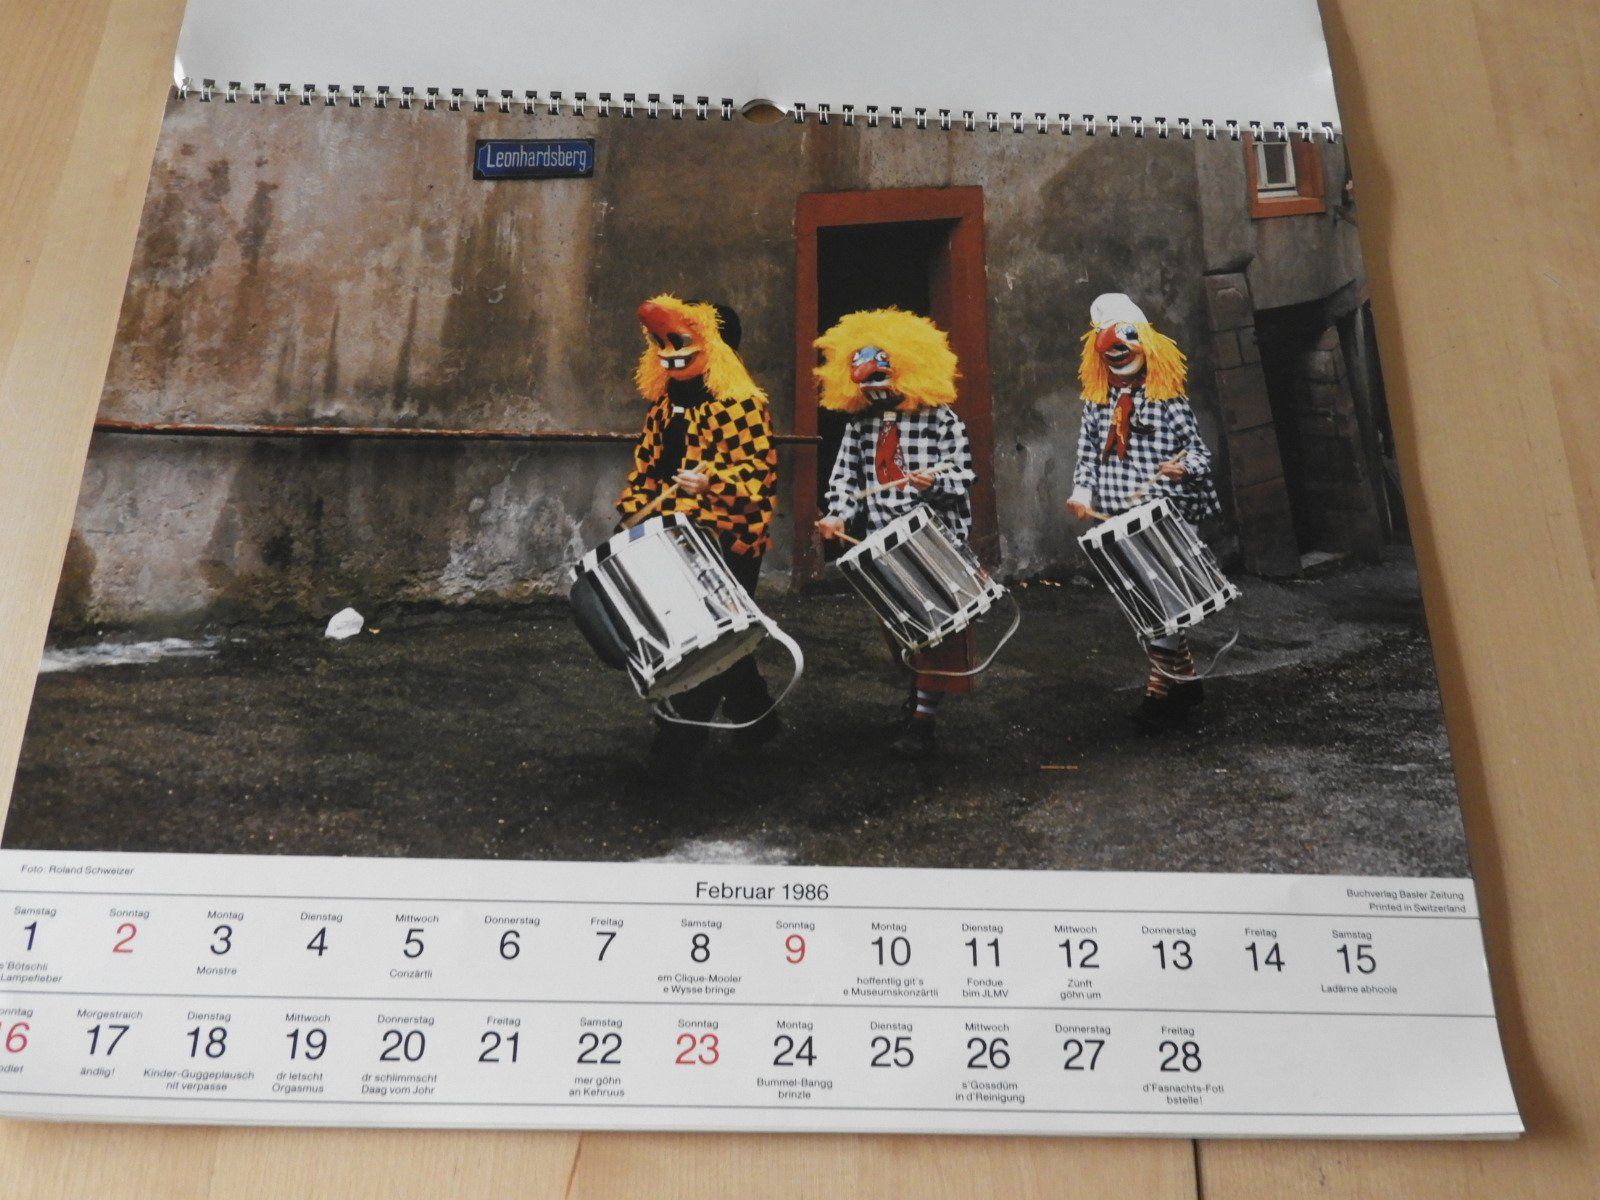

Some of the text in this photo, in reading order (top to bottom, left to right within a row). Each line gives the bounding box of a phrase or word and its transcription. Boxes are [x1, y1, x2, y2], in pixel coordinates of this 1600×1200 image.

[486, 145, 587, 172] Leonhardsberg
[48, 864, 84, 875] Roland
[84, 865, 135, 876] Schweizer
[695, 881, 829, 902] Februar 1986
[1346, 888, 1464, 901] Buchverlag Basler Zeitung
[13, 905, 57, 918] Samstag
[109, 907, 150, 920] Sonntag
[1368, 902, 1467, 914] Printed in Switzerland
[207, 909, 245, 922] Montag
[299, 911, 344, 924] Dienstag
[395, 913, 440, 924] Mittwoch
[484, 915, 541, 928] Donnerstag
[590, 916, 624, 929] Freitag
[680, 918, 723, 931] Samstag
[775, 919, 816, 932] Sonntag
[871, 921, 907, 933] Montag
[961, 923, 1004, 935] Dienstag
[1054, 924, 1098, 934] Mittwoch
[24, 921, 37, 951] 1
[113, 923, 137, 953] 2
[1141, 925, 1197, 938] Donnerstag
[1244, 927, 1278, 940] Freitag
[1331, 929, 1373, 942] Samstag
[210, 924, 232, 955] 3
[307, 927, 328, 956] 4
[403, 928, 424, 959] 5
[500, 930, 520, 960] 6
[596, 931, 616, 961] 7
[691, 933, 710, 963] 8
[785, 934, 805, 964] 9
[872, 936, 911, 966] 10
[965, 938, 999, 967] 11
[1059, 938, 1099, 968] 12
[1152, 940, 1193, 970] 13
[1245, 942, 1285, 972] 14
[1337, 944, 1376, 975] 15
[196, 965, 238, 976] Monstre
[657, 974, 673, 982] em
[966, 977, 1004, 988] Fondue
[662, 984, 736, 997] e Wysse bringe
[842, 988, 849, 997] e
[962, 988, 1009, 999] bim JLMV
[1059, 990, 1102, 1001] göhn um
[0, 1007, 33, 1018] onntag
[76, 1008, 144, 1021] Morgestraich
[187, 1010, 232, 1024] Dienstag
[285, 1012, 331, 1023] Mittwoch
[377, 1014, 435, 1027] Donnerstag
[486, 1015, 521, 1028] Freitag
[579, 1016, 623, 1030] Samstag
[677, 1018, 719, 1031] Sonntag
[776, 1019, 814, 1032] Montag
[869, 1020, 914, 1034] Dienstag
[964, 1021, 1010, 1033] Mittwoch
[1054, 1023, 1111, 1036] Donnerstag
[1160, 1025, 1195, 1038] Freitag
[0, 1022, 30, 1053] 6
[87, 1024, 130, 1056] 17
[187, 1026, 227, 1058] 18
[287, 1028, 327, 1061] 19
[380, 1029, 425, 1062] 20
[478, 1031, 519, 1063] 21
[577, 1032, 622, 1064] 22
[675, 1033, 719, 1065] 23
[773, 1034, 817, 1066] 24
[871, 1036, 914, 1068] 25
[967, 1037, 1010, 1070] 26
[1063, 1039, 1105, 1071] 27
[1159, 1040, 1202, 1073] 28
[276, 1072, 287, 1081] dr
[361, 1073, 372, 1082] dr
[574, 1075, 622, 1089] mer göhn
[165, 1081, 228, 1093] nit verpasse
[271, 1082, 324, 1095] Orgasmus
[361, 1083, 436, 1097] Daag vom Johr
[568, 1088, 581, 1097] an
[955, 1092, 965, 1101] in
